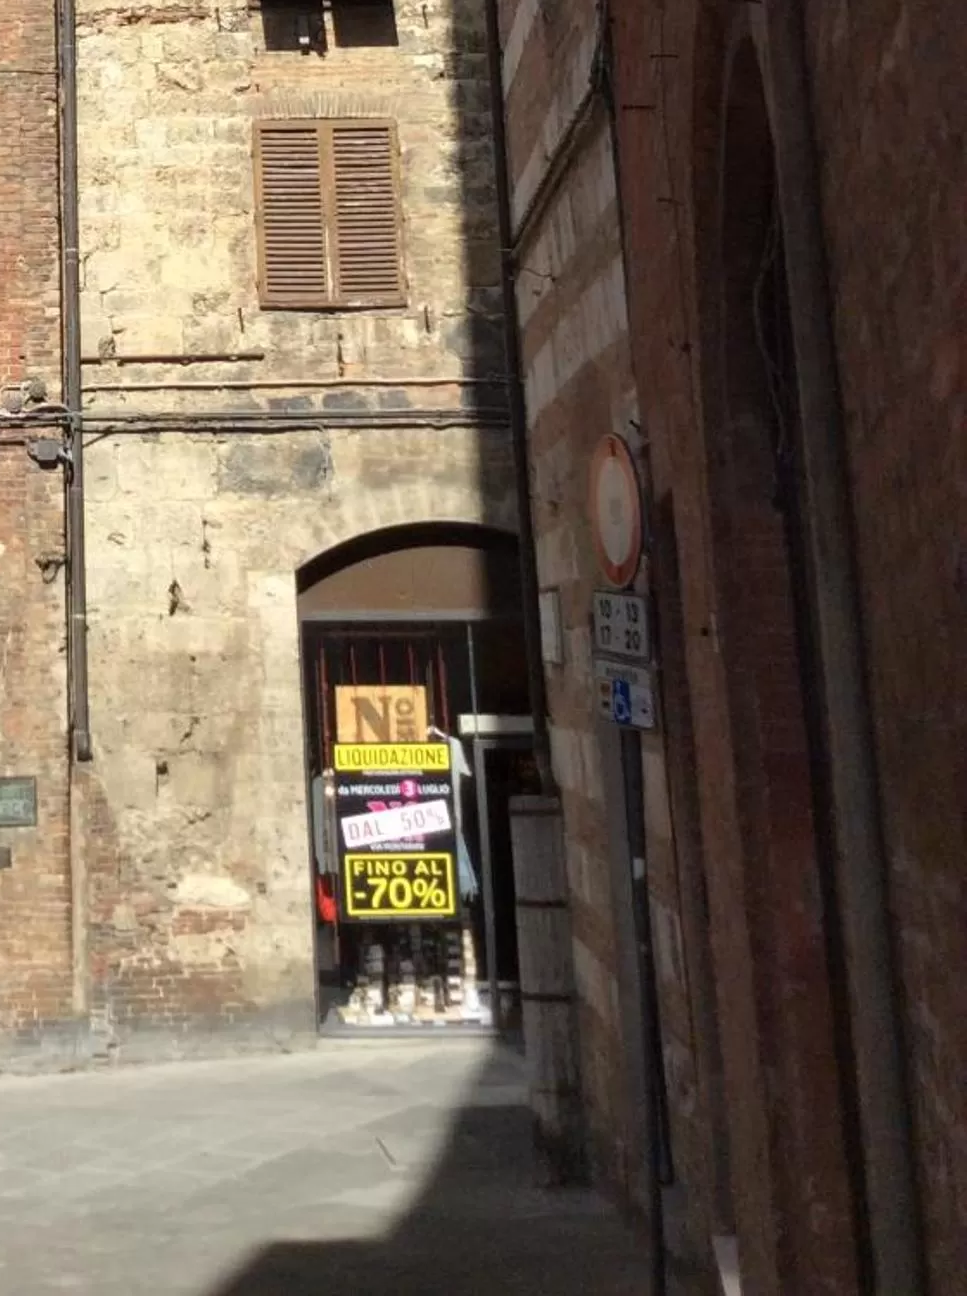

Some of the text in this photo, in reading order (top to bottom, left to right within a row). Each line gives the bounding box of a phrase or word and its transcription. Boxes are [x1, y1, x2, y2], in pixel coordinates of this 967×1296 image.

[337, 747, 446, 766] LIQUIDAZIONE
[348, 808, 445, 841] DAL 50%
[353, 860, 443, 876] FINO AL
[354, 877, 446, 908] -70%
